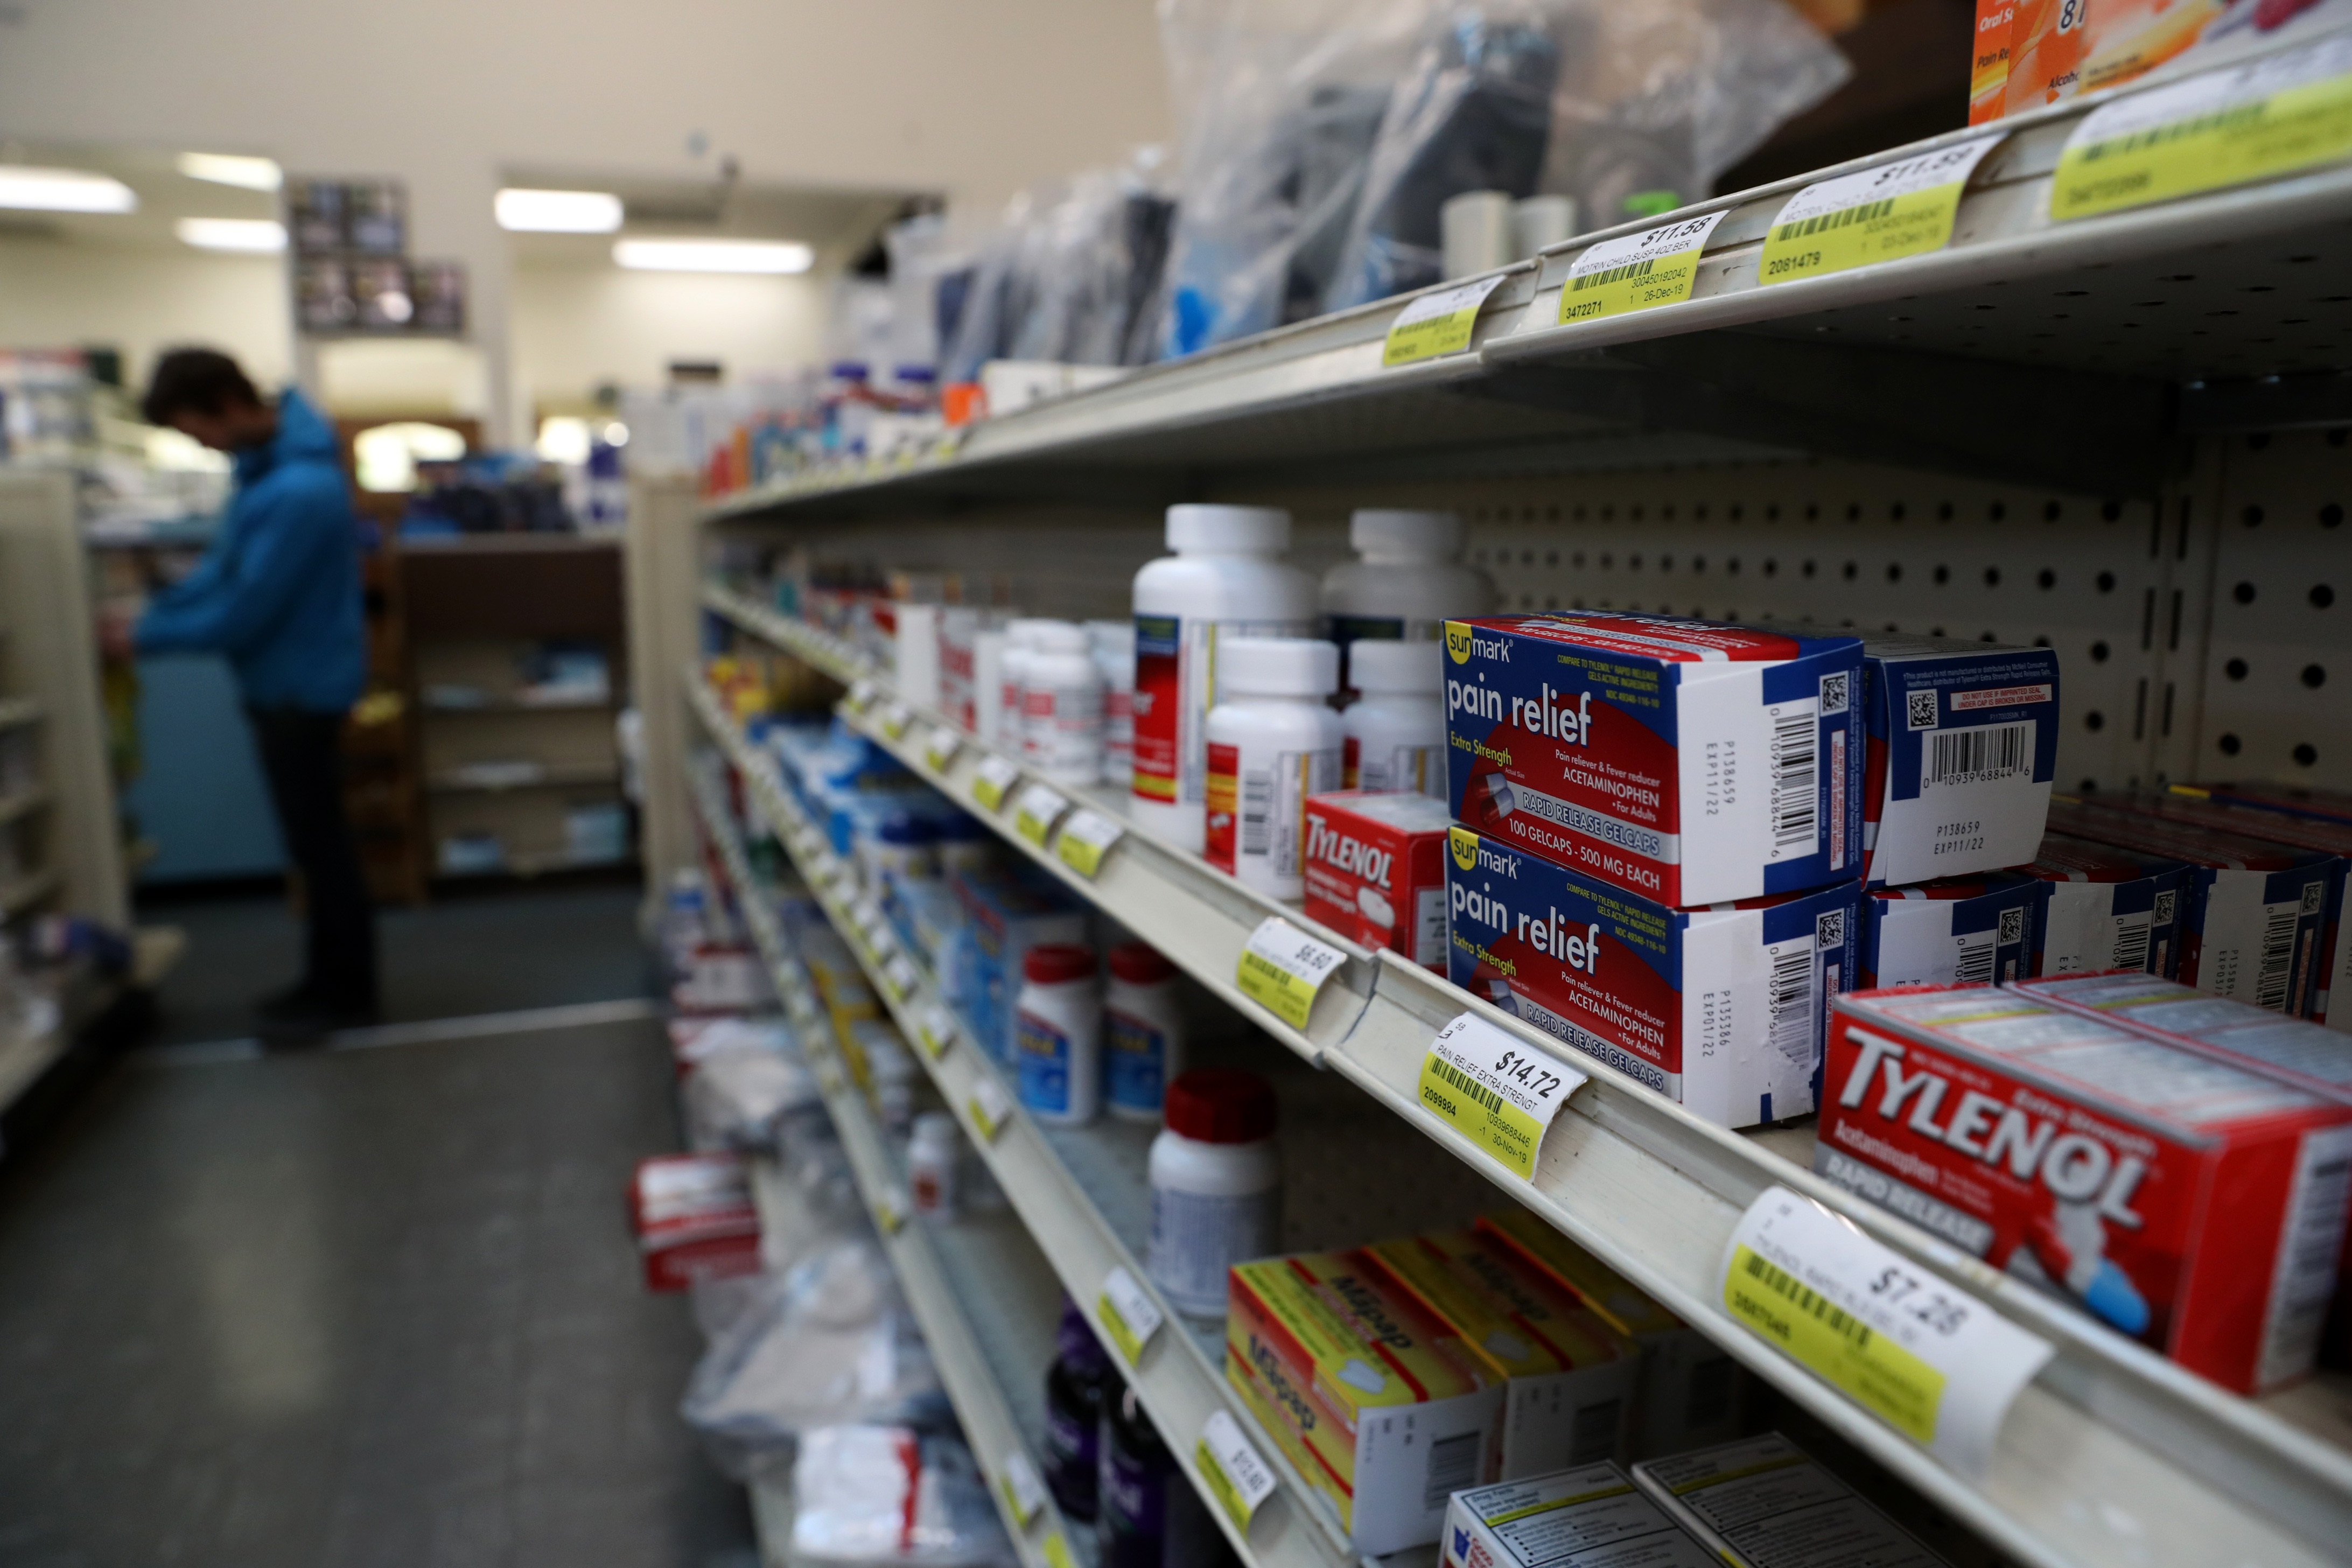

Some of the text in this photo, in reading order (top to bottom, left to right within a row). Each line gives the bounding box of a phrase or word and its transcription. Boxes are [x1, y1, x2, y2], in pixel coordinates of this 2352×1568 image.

[1979, 11, 2002, 32] Oral
[1977, 52, 1997, 68] Pain
[1641, 217, 1712, 248] $11.58
[1577, 262, 1608, 275] MOTRIN
[1606, 255, 1630, 268] CHILD
[1632, 249, 1655, 261] SUSP
[1672, 240, 1691, 251] BER
[1769, 251, 1821, 275] 2081479
[1630, 284, 1683, 304] 1 26-Dec-19
[1632, 267, 1687, 289] 300450192042
[1566, 300, 1602, 319] 3472271
[1558, 654, 1580, 667] COMPARE
[1581, 659, 1588, 668] TO
[1588, 671, 1601, 681] GELS
[1601, 674, 1620, 685] ACTIVE
[1448, 673, 1591, 746] pain relief
[1958, 701, 1976, 709] UNDER
[1995, 697, 2015, 705] BROKEN
[2000, 688, 2028, 696] IMPRINTED
[1451, 731, 1513, 767] Extra Strength
[1505, 767, 1525, 779] Actual Size
[1556, 749, 1661, 788] Pain reliever & Fever reducer
[1706, 743, 1719, 816] EXP11/22
[1724, 741, 1735, 804] P138659
[1923, 766, 2029, 788] 0 10939 68844 6
[1563, 766, 1660, 808] ACETAMINOPHEN
[1522, 792, 1660, 856] RAPID RELEASE GELCAPS
[1630, 804, 1657, 822] Adults
[1937, 821, 1980, 837] P138659
[1307, 813, 1393, 888] TYLENOL
[1509, 818, 1661, 891] 100 GELCAPS 500 MG EACH
[1934, 837, 1984, 855] EXP11/22
[1567, 883, 1590, 899] COMPARE
[1591, 892, 1598, 901] TO
[1625, 905, 1641, 919] RAPID
[1642, 912, 1666, 929] RELEASE
[1597, 905, 1611, 917] GELS
[1611, 911, 1629, 925] ACTIVE
[1451, 882, 1600, 974] pain relief
[1615, 926, 1626, 937] NDC
[1453, 930, 1516, 977] Extra Strength
[1562, 971, 1665, 1028] Pain reliever & Fever reducer
[1769, 972, 1779, 1014] 10939
[1569, 990, 1664, 1047] ACETAMINOPHEN
[1703, 992, 1714, 1057] EXP01/22
[1719, 990, 1731, 1046] P135386
[1527, 1004, 1663, 1091] RAPID RELEASE GELCAPS
[1635, 1038, 1661, 1060] Adults
[1437, 1045, 1538, 1112] PAIN RELIEF EXTRA STRENGT
[1495, 1051, 1560, 1098] $14.72
[1424, 1087, 1457, 1117] 2099984
[1487, 1112, 1530, 1147] 10939688446
[1839, 1025, 2148, 1229] TYLENOL
[1493, 1133, 1527, 1164] 30-Nov-19
